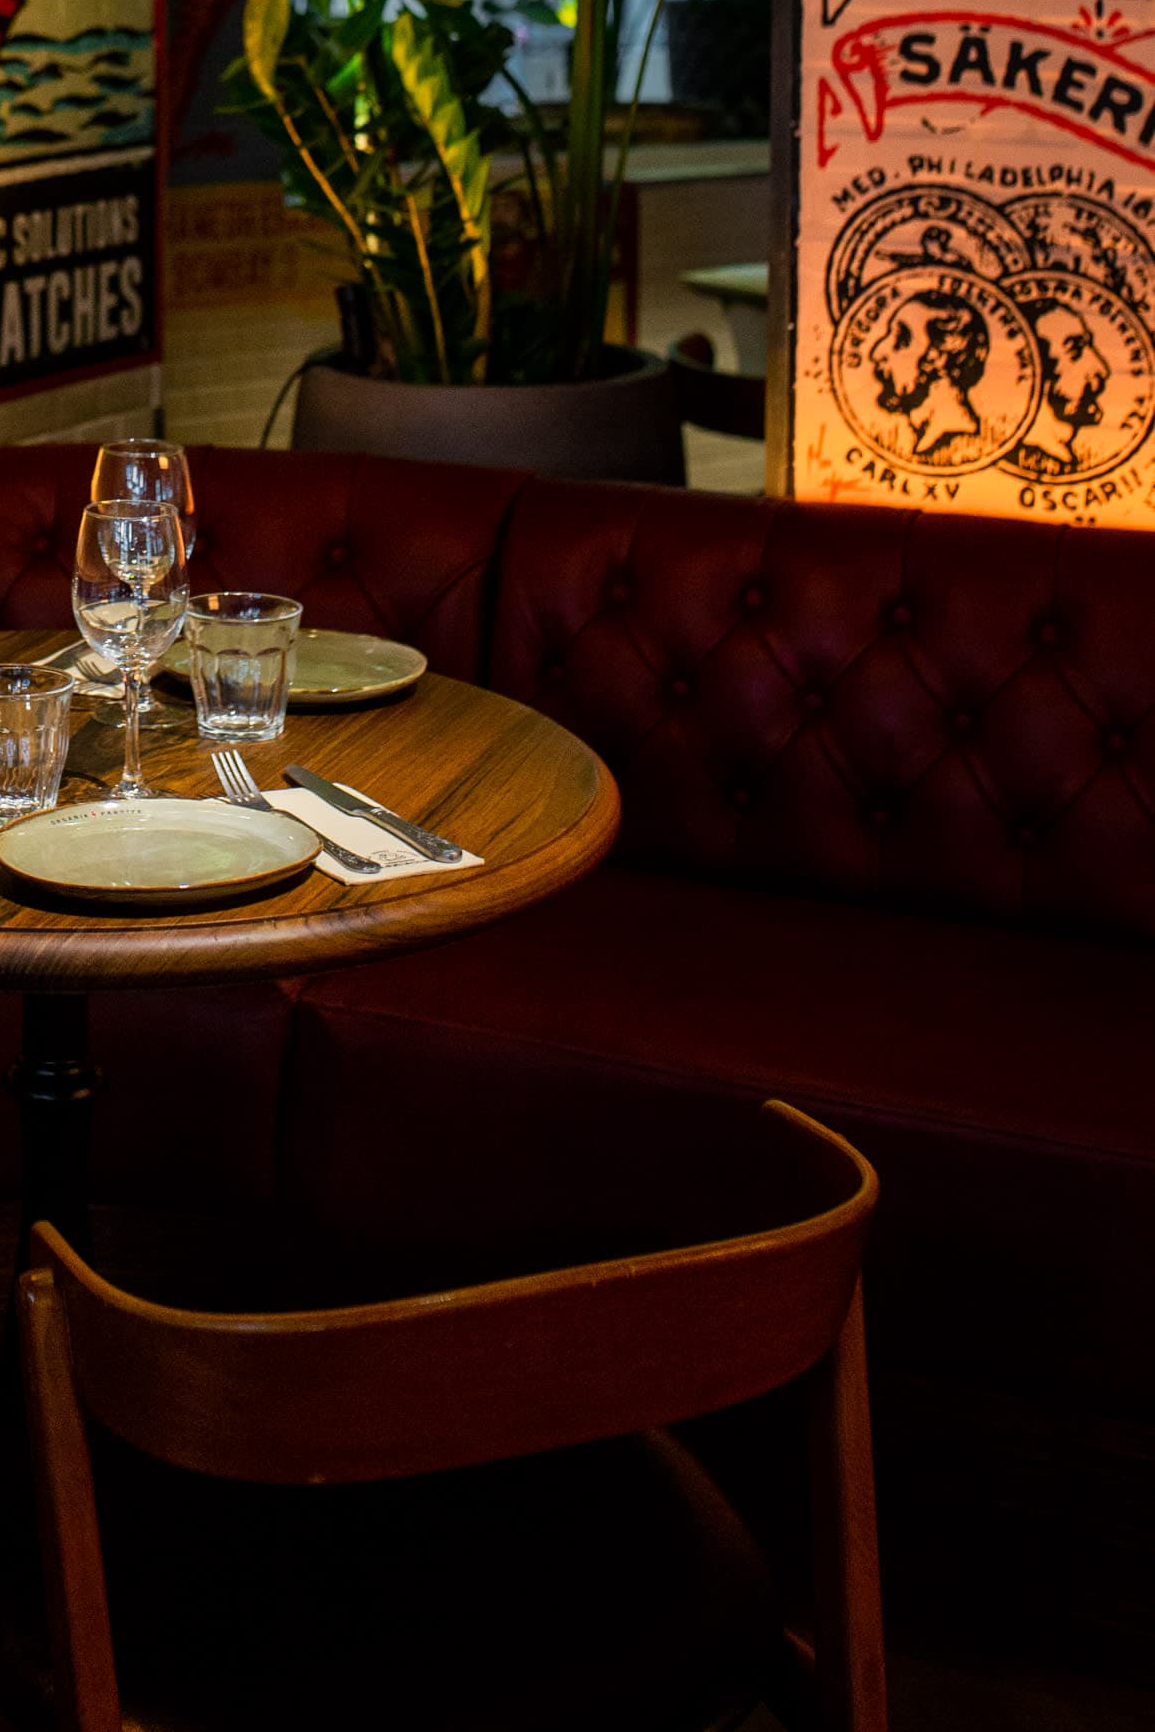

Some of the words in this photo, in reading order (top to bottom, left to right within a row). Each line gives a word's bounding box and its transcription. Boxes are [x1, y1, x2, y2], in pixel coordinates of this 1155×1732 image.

[907, 155, 1116, 200] PHILADELPHIA
[12, 194, 139, 257] SOLUTIONS
[846, 446, 913, 495] CARL
[925, 482, 960, 502] XV
[1019, 479, 1123, 510] OSCAR
